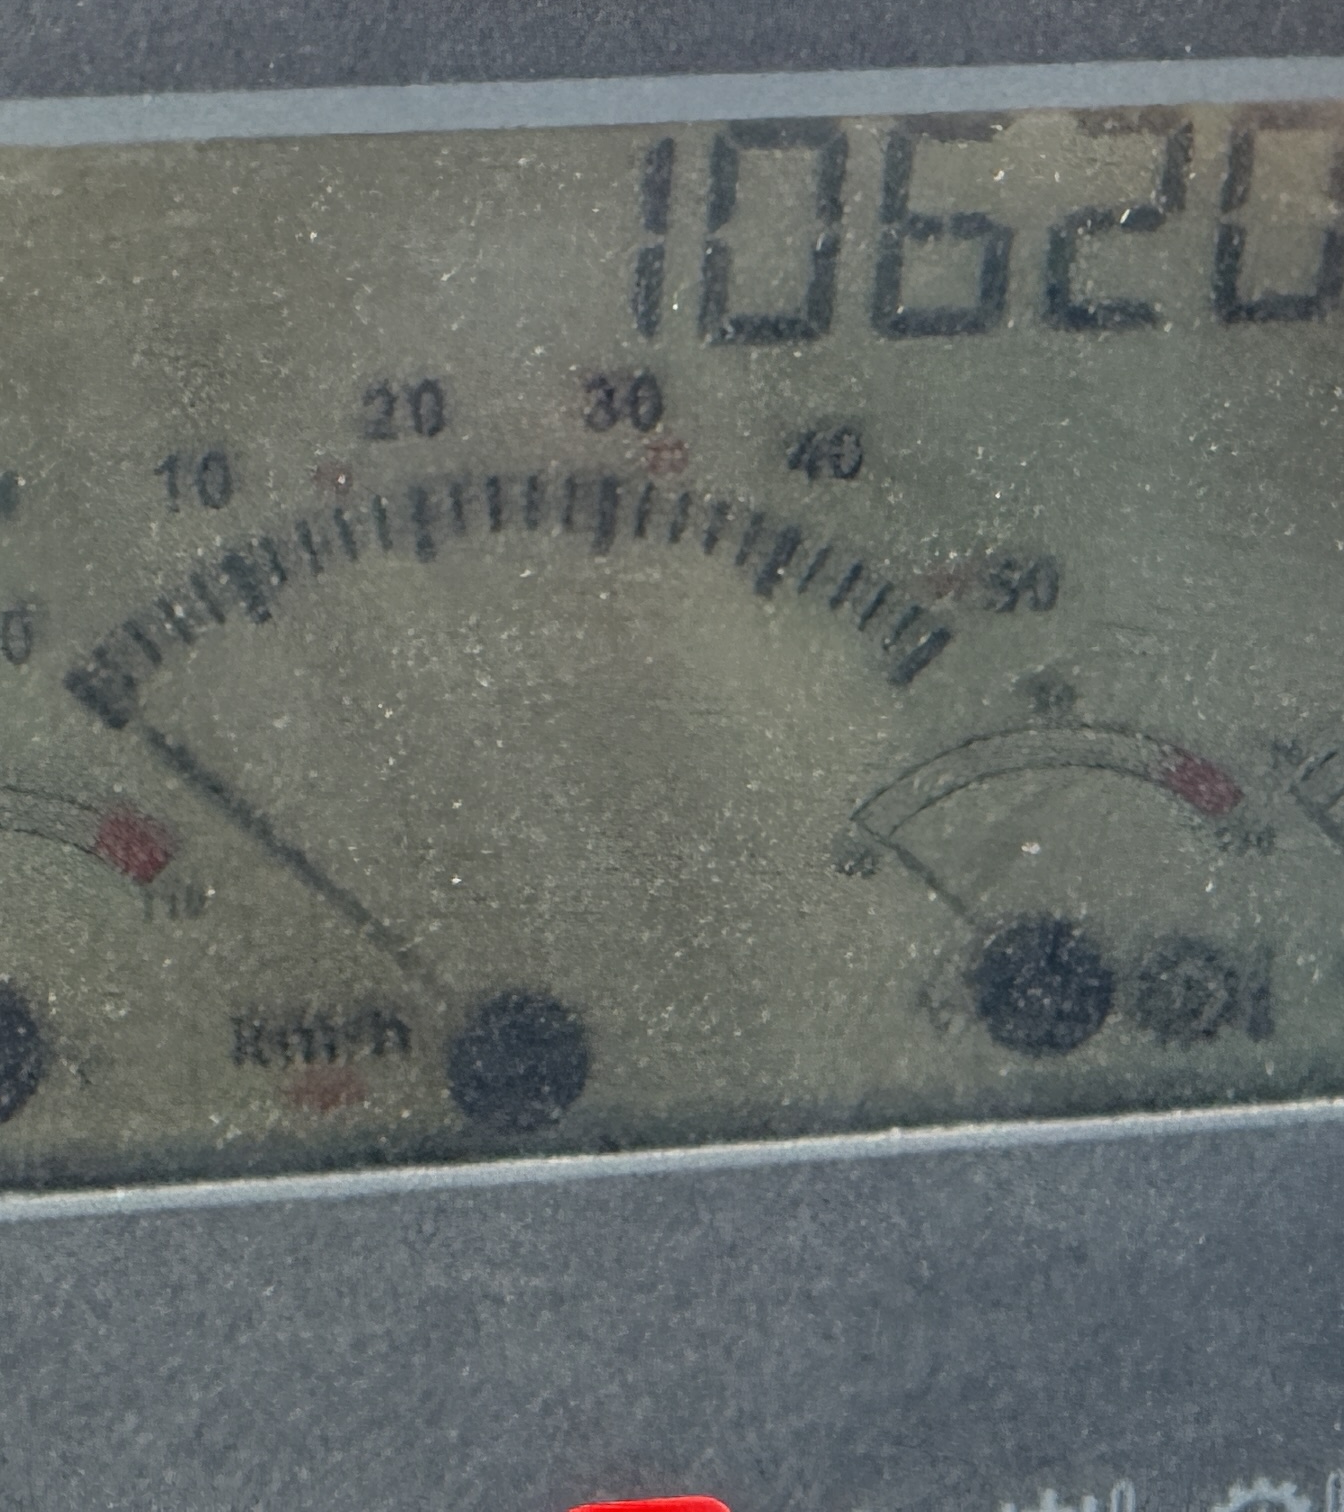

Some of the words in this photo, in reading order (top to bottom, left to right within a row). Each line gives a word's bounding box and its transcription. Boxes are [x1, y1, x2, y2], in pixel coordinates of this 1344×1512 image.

[361, 378, 446, 440] 20
[582, 372, 665, 433] 30
[156, 450, 234, 513] 10
[788, 424, 863, 480] 40
